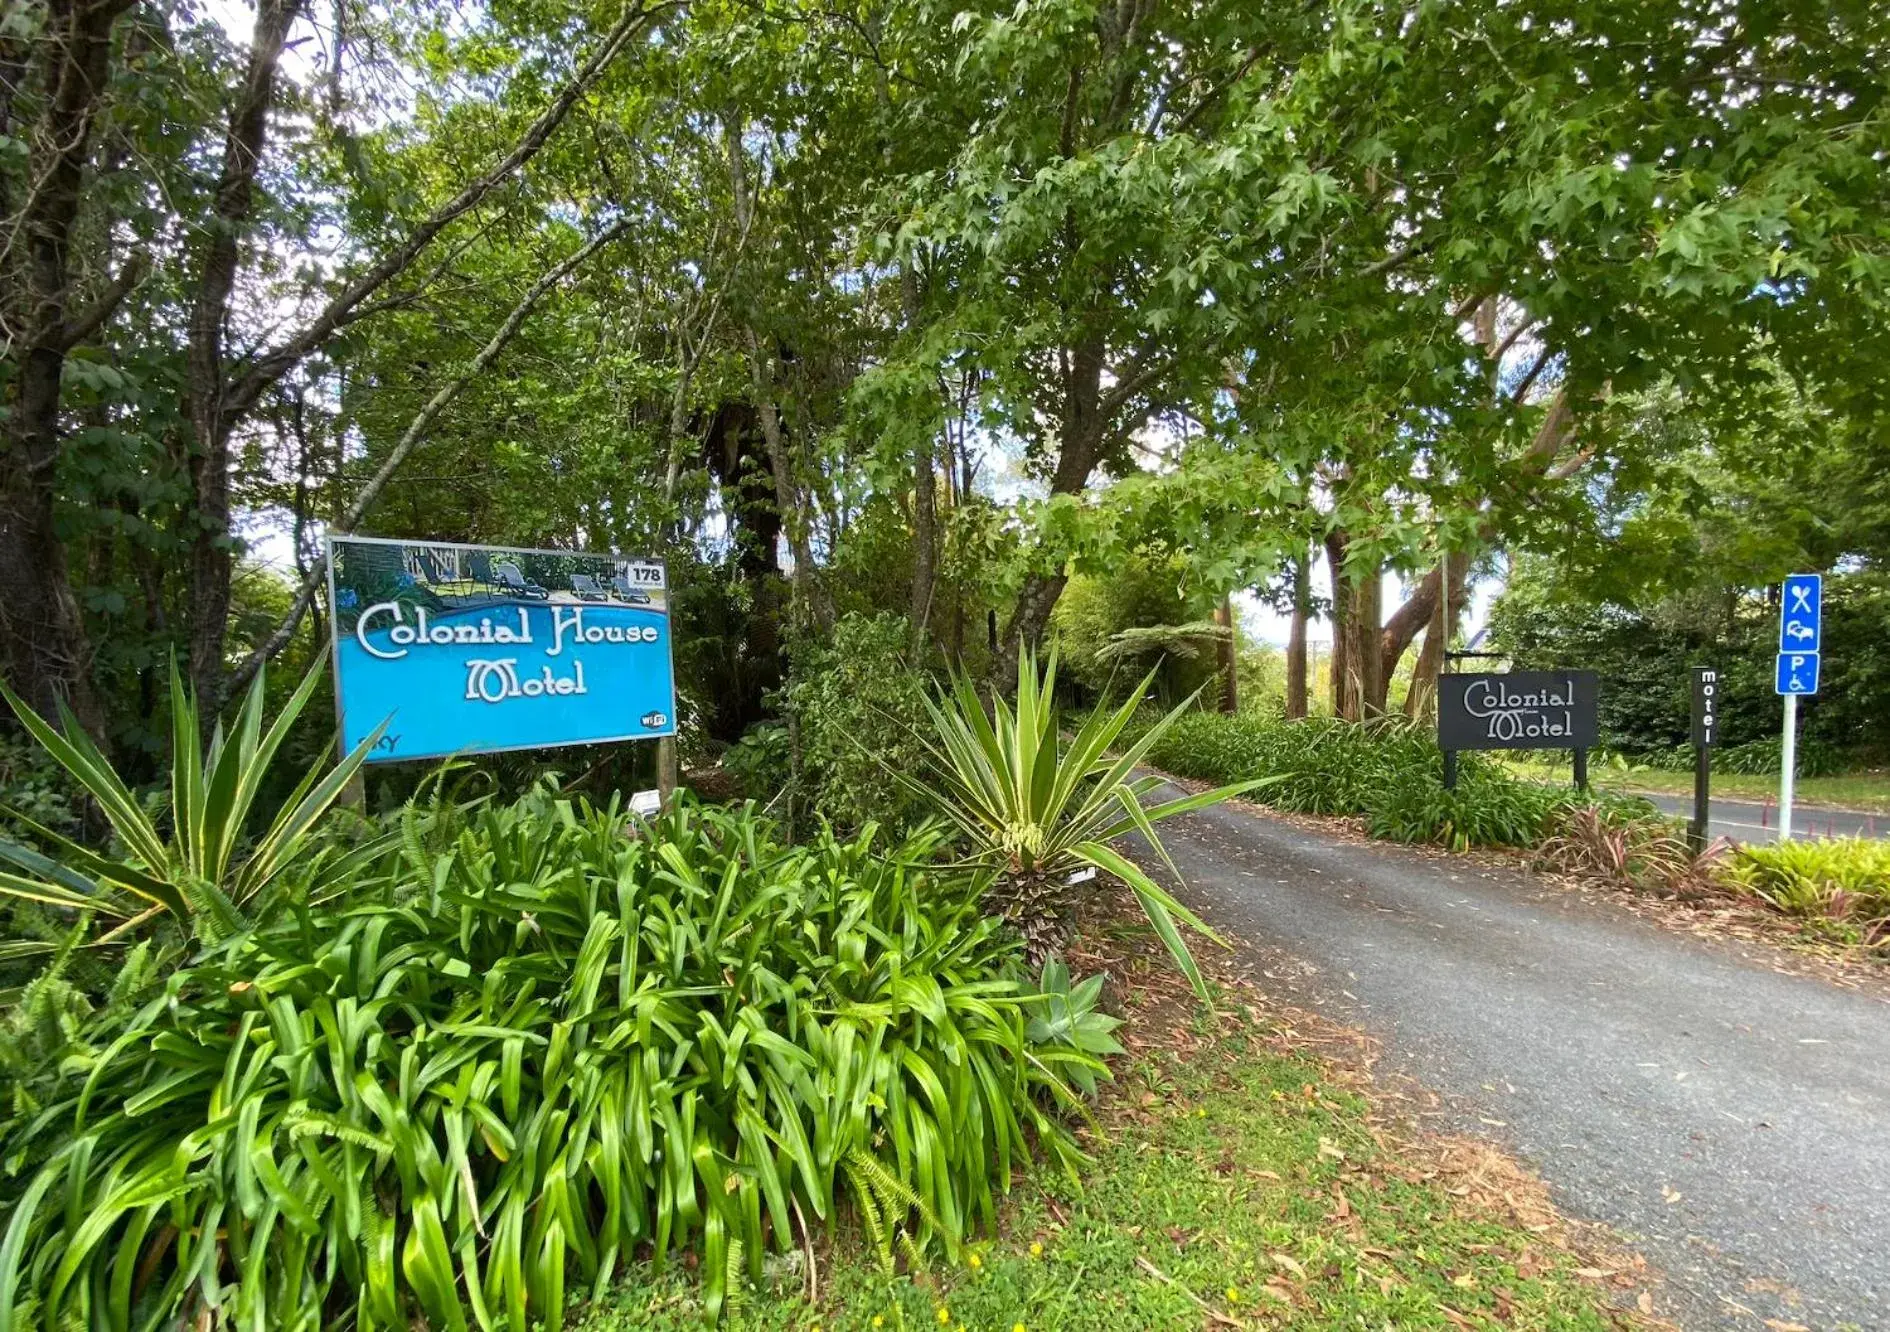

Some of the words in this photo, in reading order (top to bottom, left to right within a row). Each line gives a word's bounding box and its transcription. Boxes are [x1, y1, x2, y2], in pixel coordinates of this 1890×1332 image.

[633, 567, 661, 581] 178
[357, 601, 533, 656] Colonial
[545, 605, 658, 656] House
[465, 659, 587, 703] Motel
[1791, 656, 1805, 671] P
[1464, 679, 1575, 718] Colonial
[1701, 671, 1716, 743] motel
[1487, 709, 1573, 741] Motel
